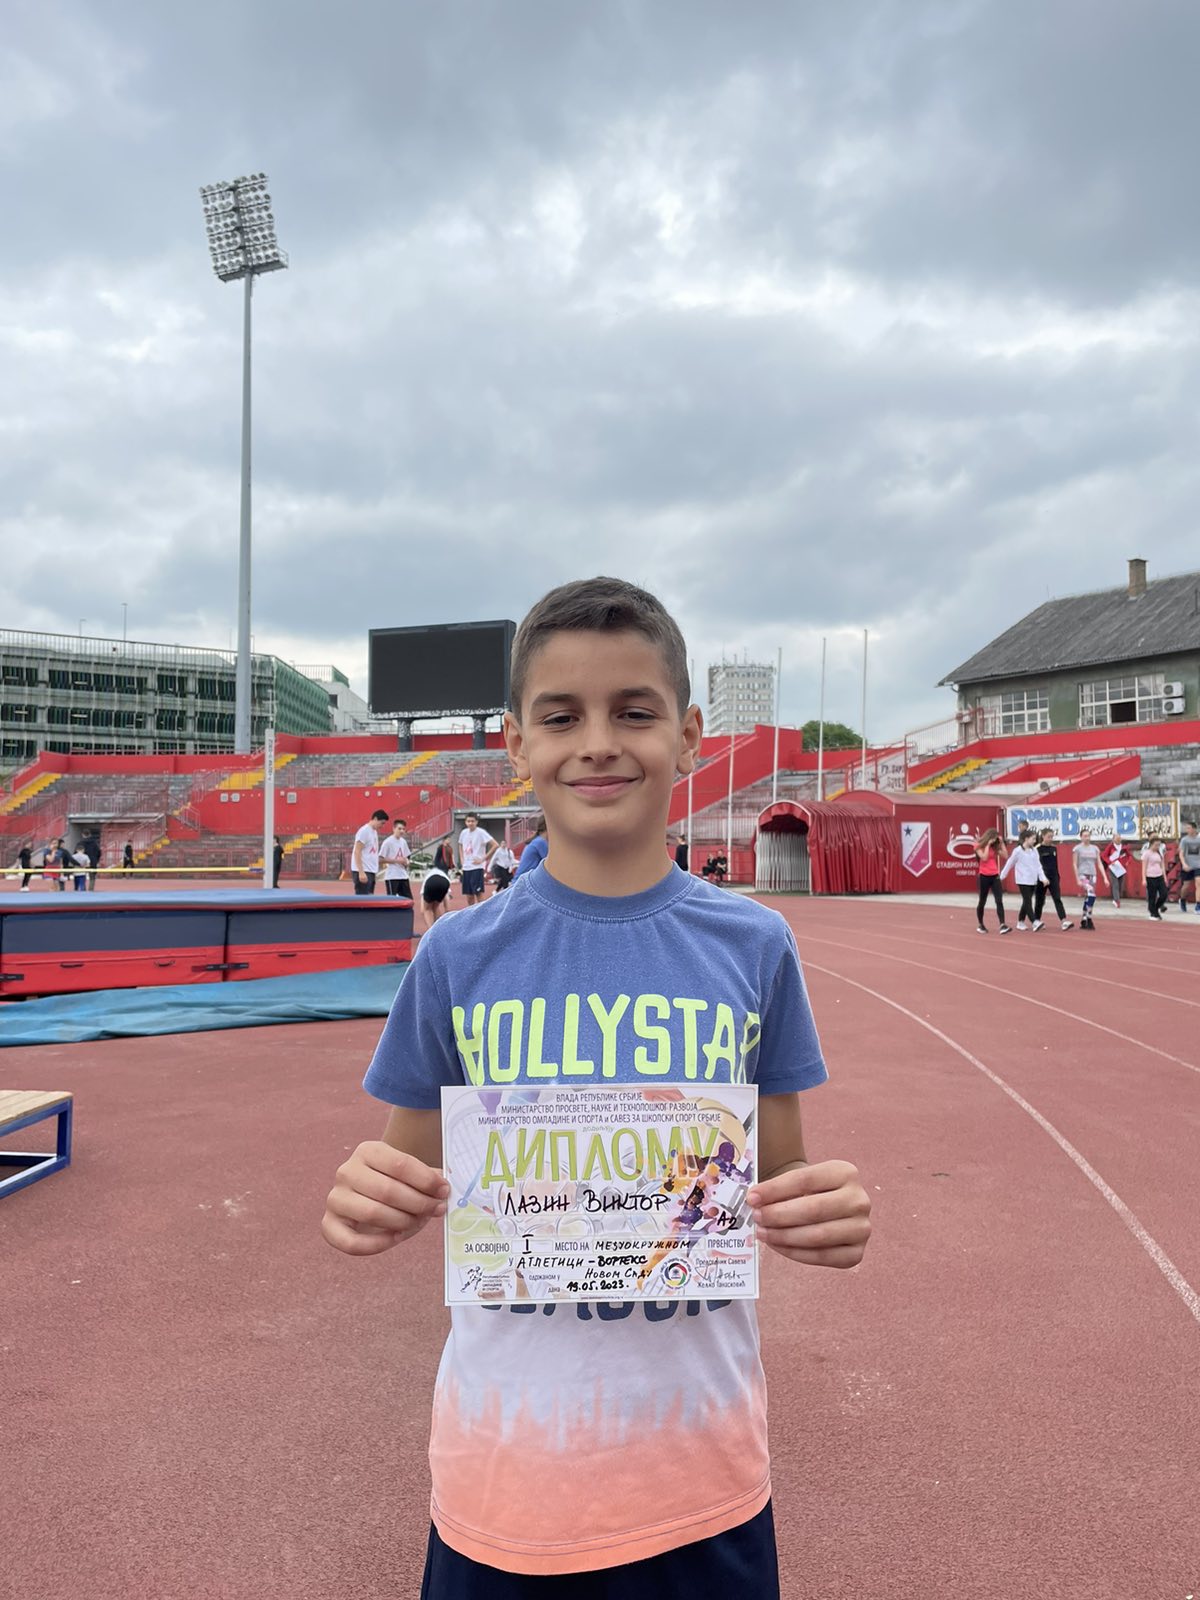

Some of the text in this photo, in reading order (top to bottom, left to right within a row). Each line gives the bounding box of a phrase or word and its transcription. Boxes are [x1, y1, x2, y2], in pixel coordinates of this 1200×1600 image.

[1061, 806, 1114, 836] BOBAR
[936, 861, 963, 869] СТАДИОН
[556, 1092, 642, 1103] ВЛАДА РЕПУБЛИКЕ СРБИЈЕ
[501, 1105, 554, 1114] МИНИСТАРСТВО
[555, 1104, 590, 1114] ПРОСВЕТЕ,
[591, 1103, 613, 1112] НАУКЕ
[619, 1102, 668, 1112] ТЕХНОЛОШКОГ
[669, 1102, 698, 1111] РАЗВОЈА
[478, 1117, 531, 1126] МИНИСТАРСТВО
[532, 1115, 570, 1125] ОМЛАДИНЕ
[577, 1114, 604, 1124] СПОРТА
[610, 1114, 631, 1123] САВЕЗ
[632, 1113, 641, 1122] ЗА
[641, 1113, 674, 1123] ШКОЛСКИ
[675, 1113, 697, 1122] СПОРТ
[698, 1112, 721, 1122] СРБИЈЕ
[481, 1127, 720, 1189] ДИПЛОМУ
[504, 1189, 671, 1216] ЛАЗИН ВИКТОР
[464, 1242, 510, 1255] ЗА ОСВОЈЕНО
[555, 1241, 590, 1251] МЕСТО НА
[707, 1238, 746, 1249] ПРВЕНСТВУ
[516, 1257, 584, 1269] АТЛЕТИЦИ
